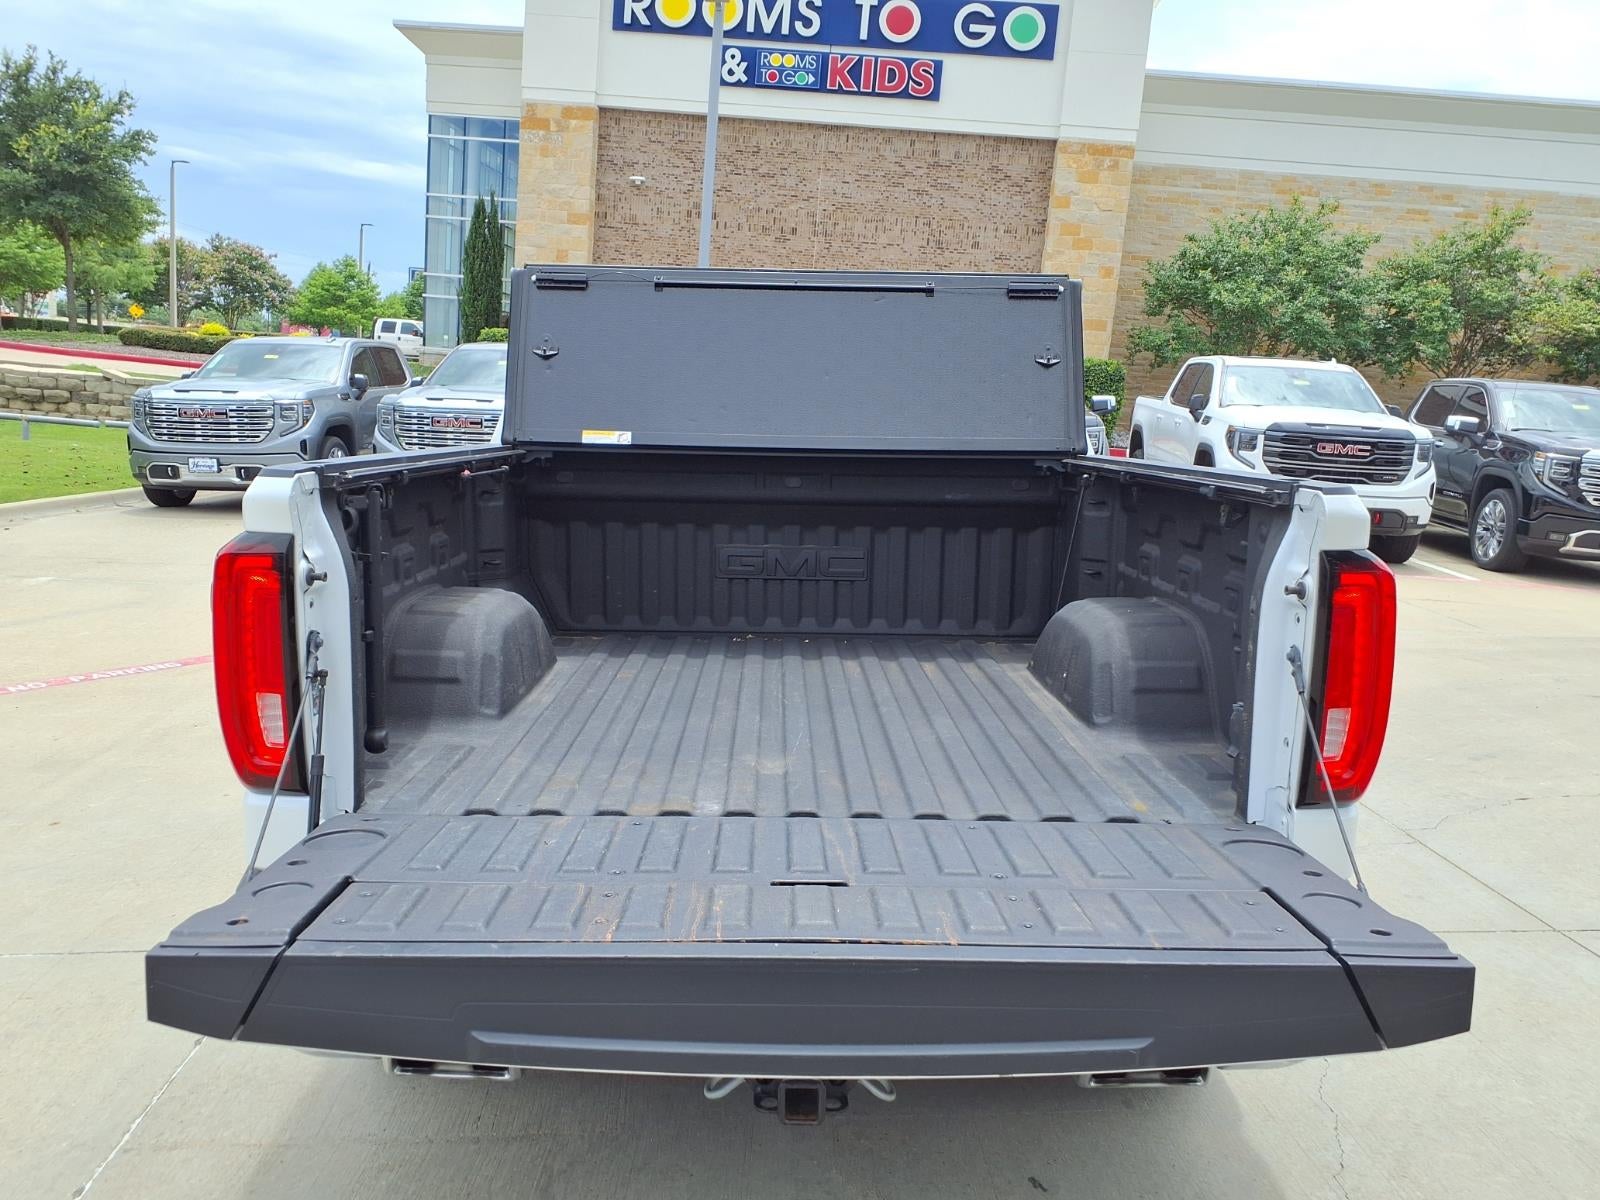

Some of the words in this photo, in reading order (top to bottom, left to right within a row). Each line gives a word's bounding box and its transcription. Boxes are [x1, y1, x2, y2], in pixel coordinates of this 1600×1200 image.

[623, 0, 823, 37] ROOMS
[855, 0, 921, 43] TO
[953, 2, 1046, 51] GO
[721, 47, 748, 83] &
[760, 52, 817, 69] ROOMS
[761, 68, 779, 83] TO
[781, 71, 808, 85] GO
[826, 54, 935, 97] KIDS
[179, 407, 227, 419] GMC
[432, 417, 482, 429] GMC
[1316, 442, 1372, 456] GMC
[717, 547, 868, 579] GMC
